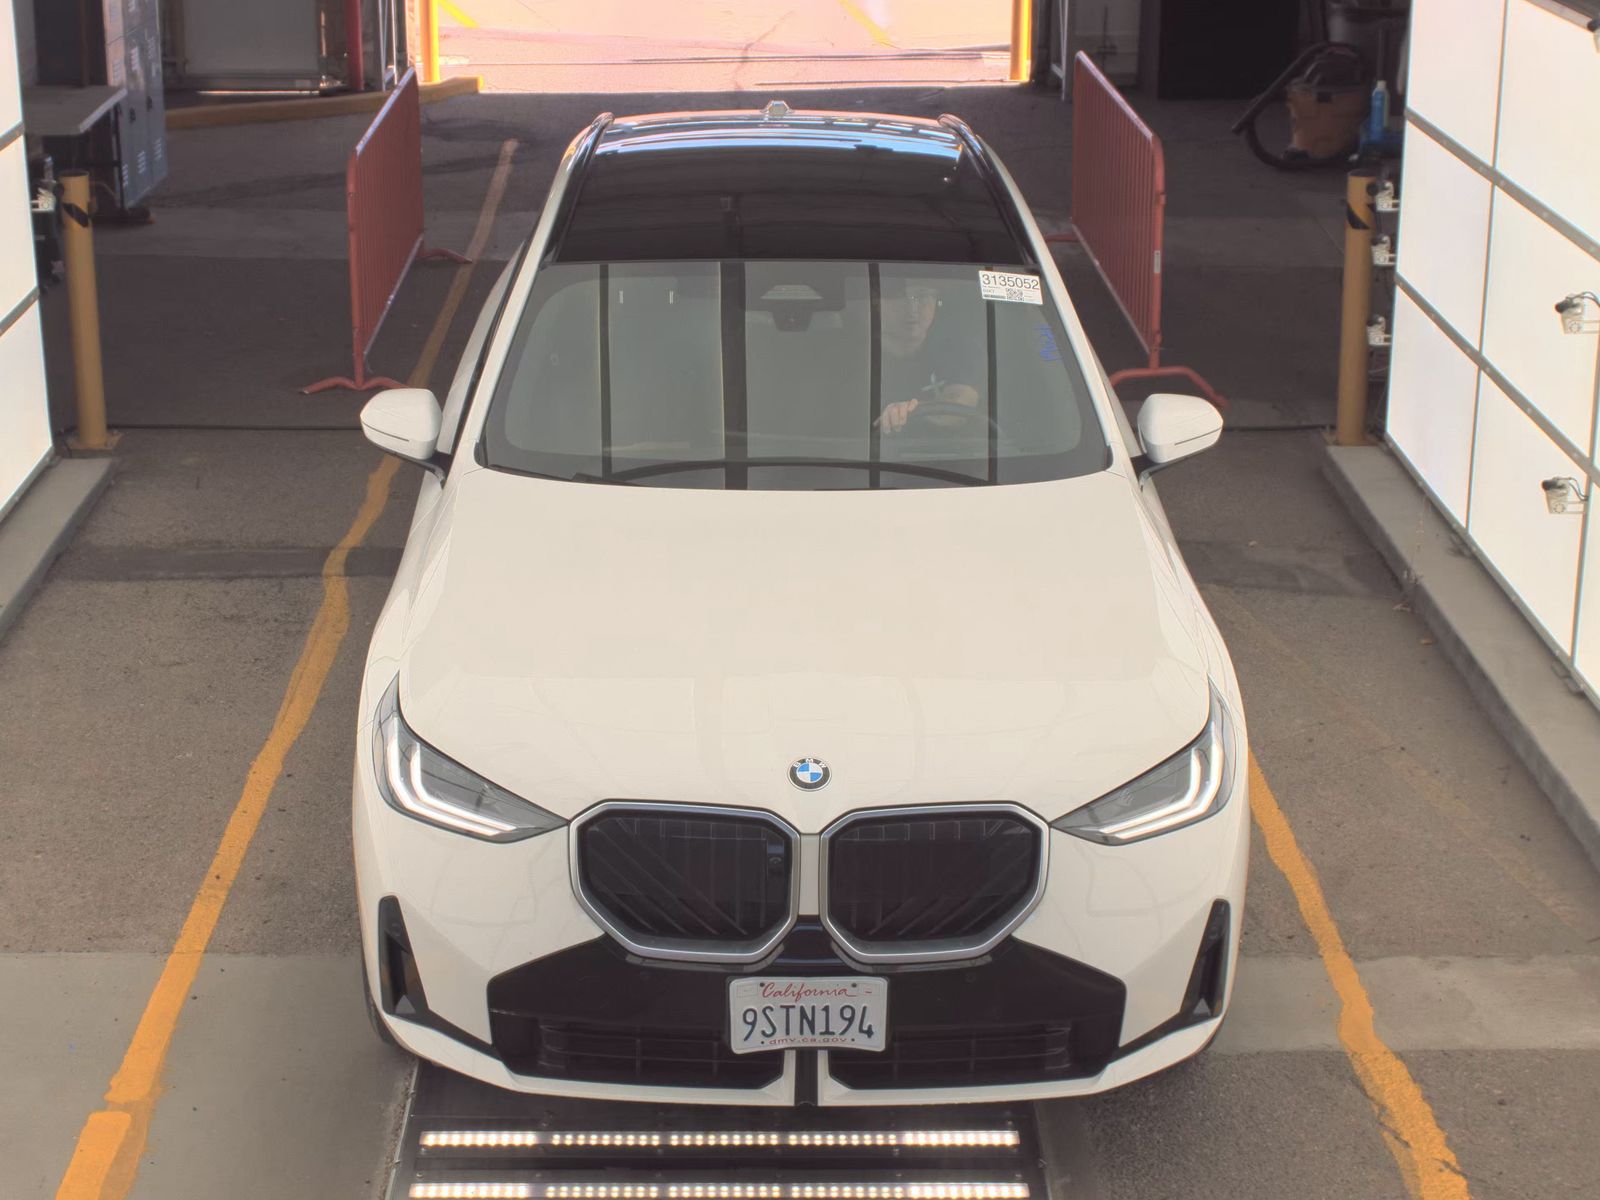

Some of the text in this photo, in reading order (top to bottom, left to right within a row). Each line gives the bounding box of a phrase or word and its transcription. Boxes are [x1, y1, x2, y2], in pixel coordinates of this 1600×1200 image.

[982, 273, 1040, 291] 3135052
[792, 757, 828, 768] BMW
[762, 982, 858, 1003] California
[742, 1004, 875, 1042] 9STN194
[768, 1036, 848, 1046] dmv.ca.gov
